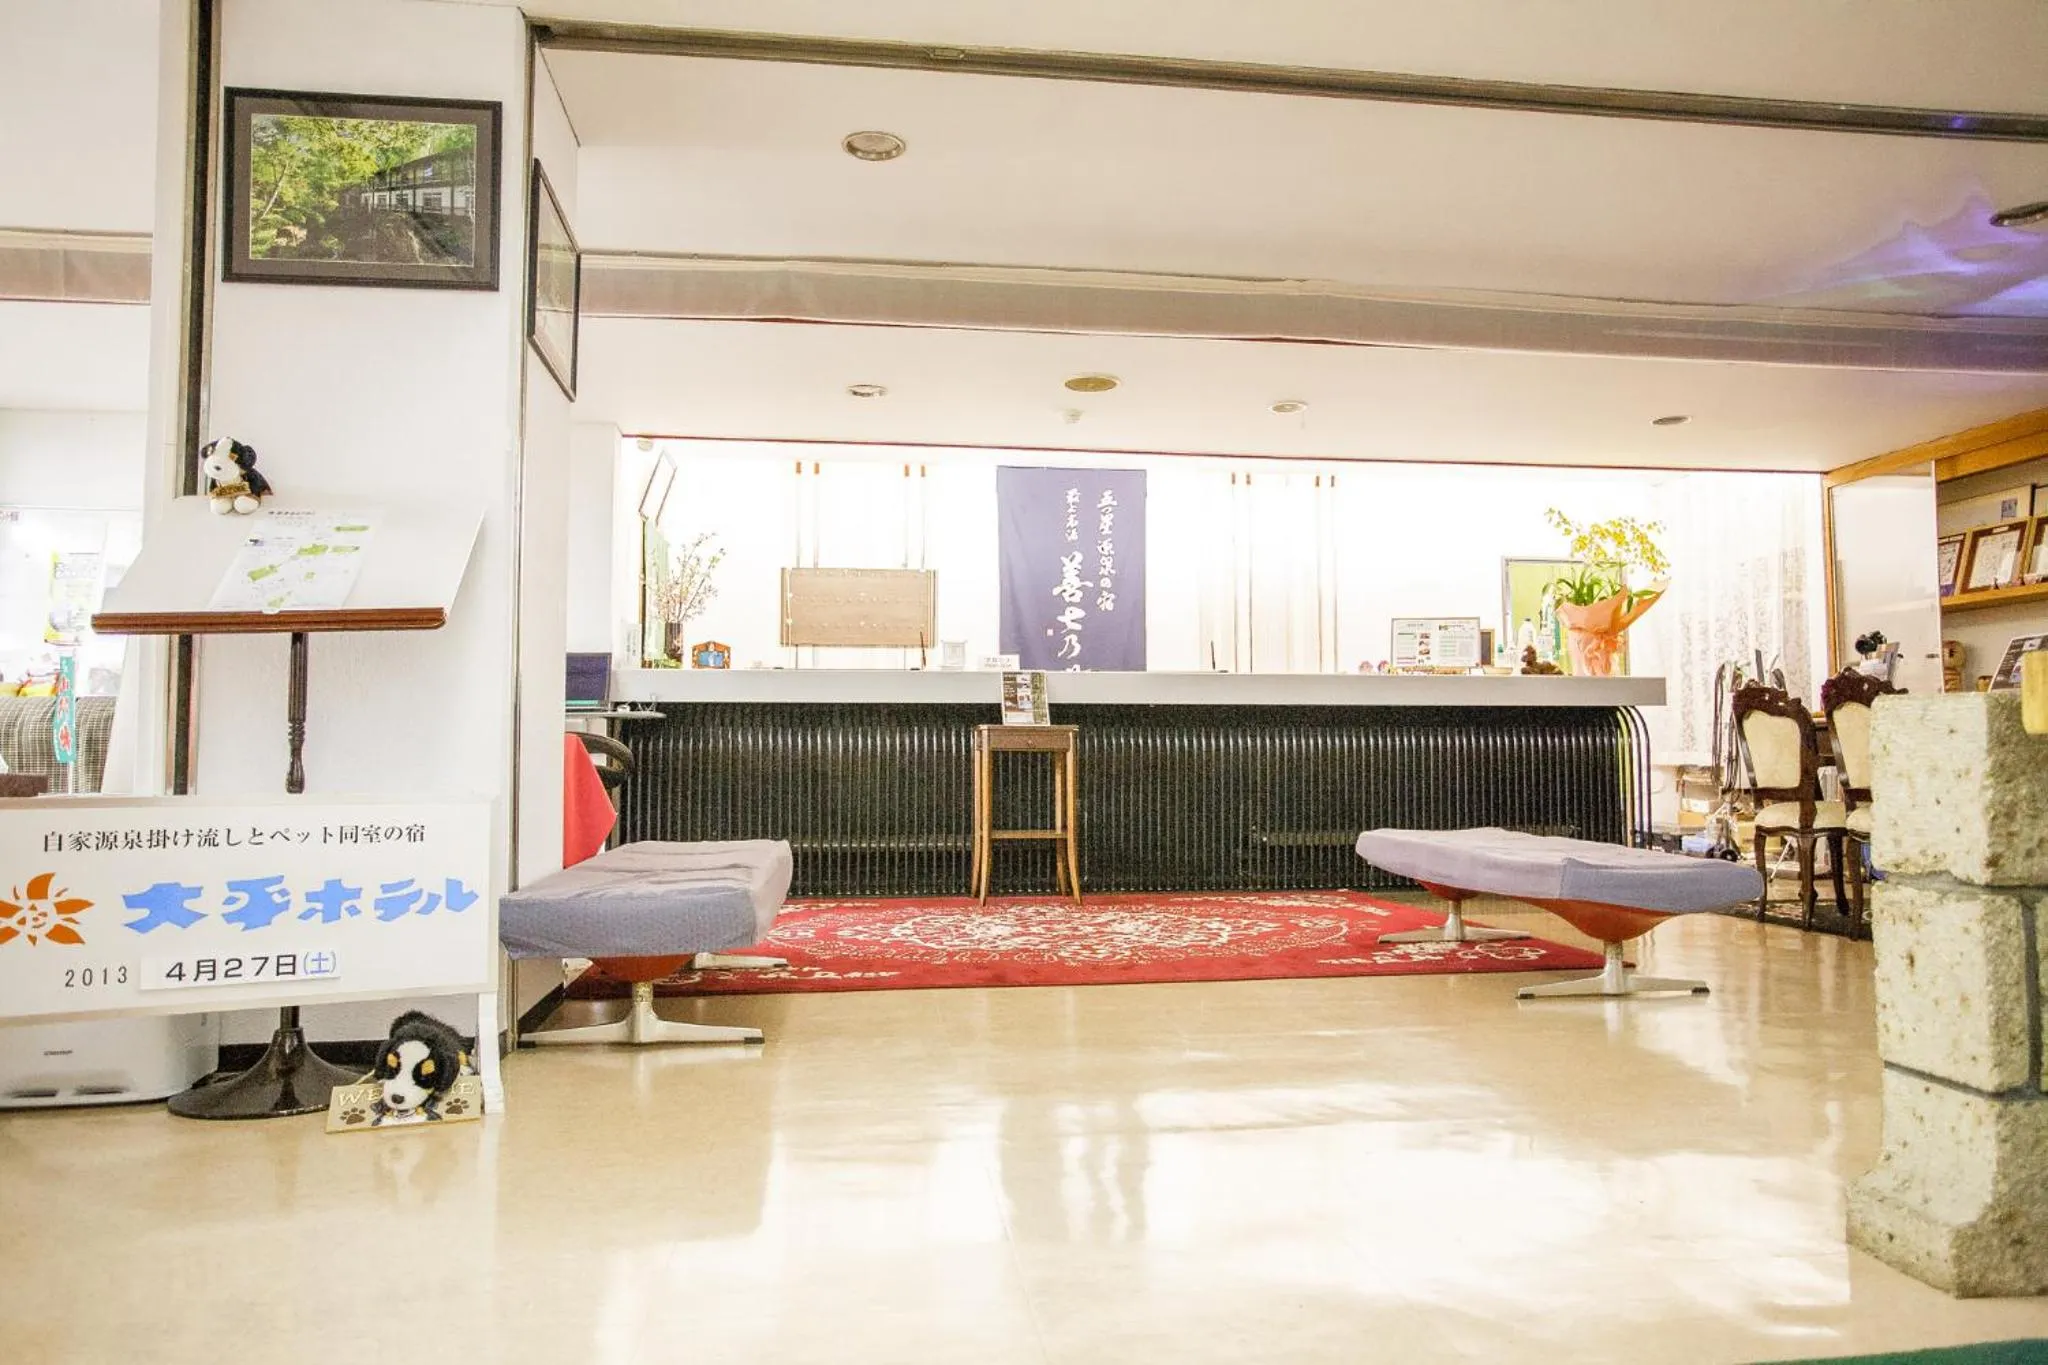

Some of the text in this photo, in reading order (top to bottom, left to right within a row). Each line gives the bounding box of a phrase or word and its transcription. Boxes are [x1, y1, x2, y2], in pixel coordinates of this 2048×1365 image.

[1052, 550, 1094, 671] 善七乃
[43, 824, 426, 853] 自家源泉掛け流しとペット同室の宿
[121, 874, 480, 935] 大平ホテル
[65, 966, 128, 988] 2013
